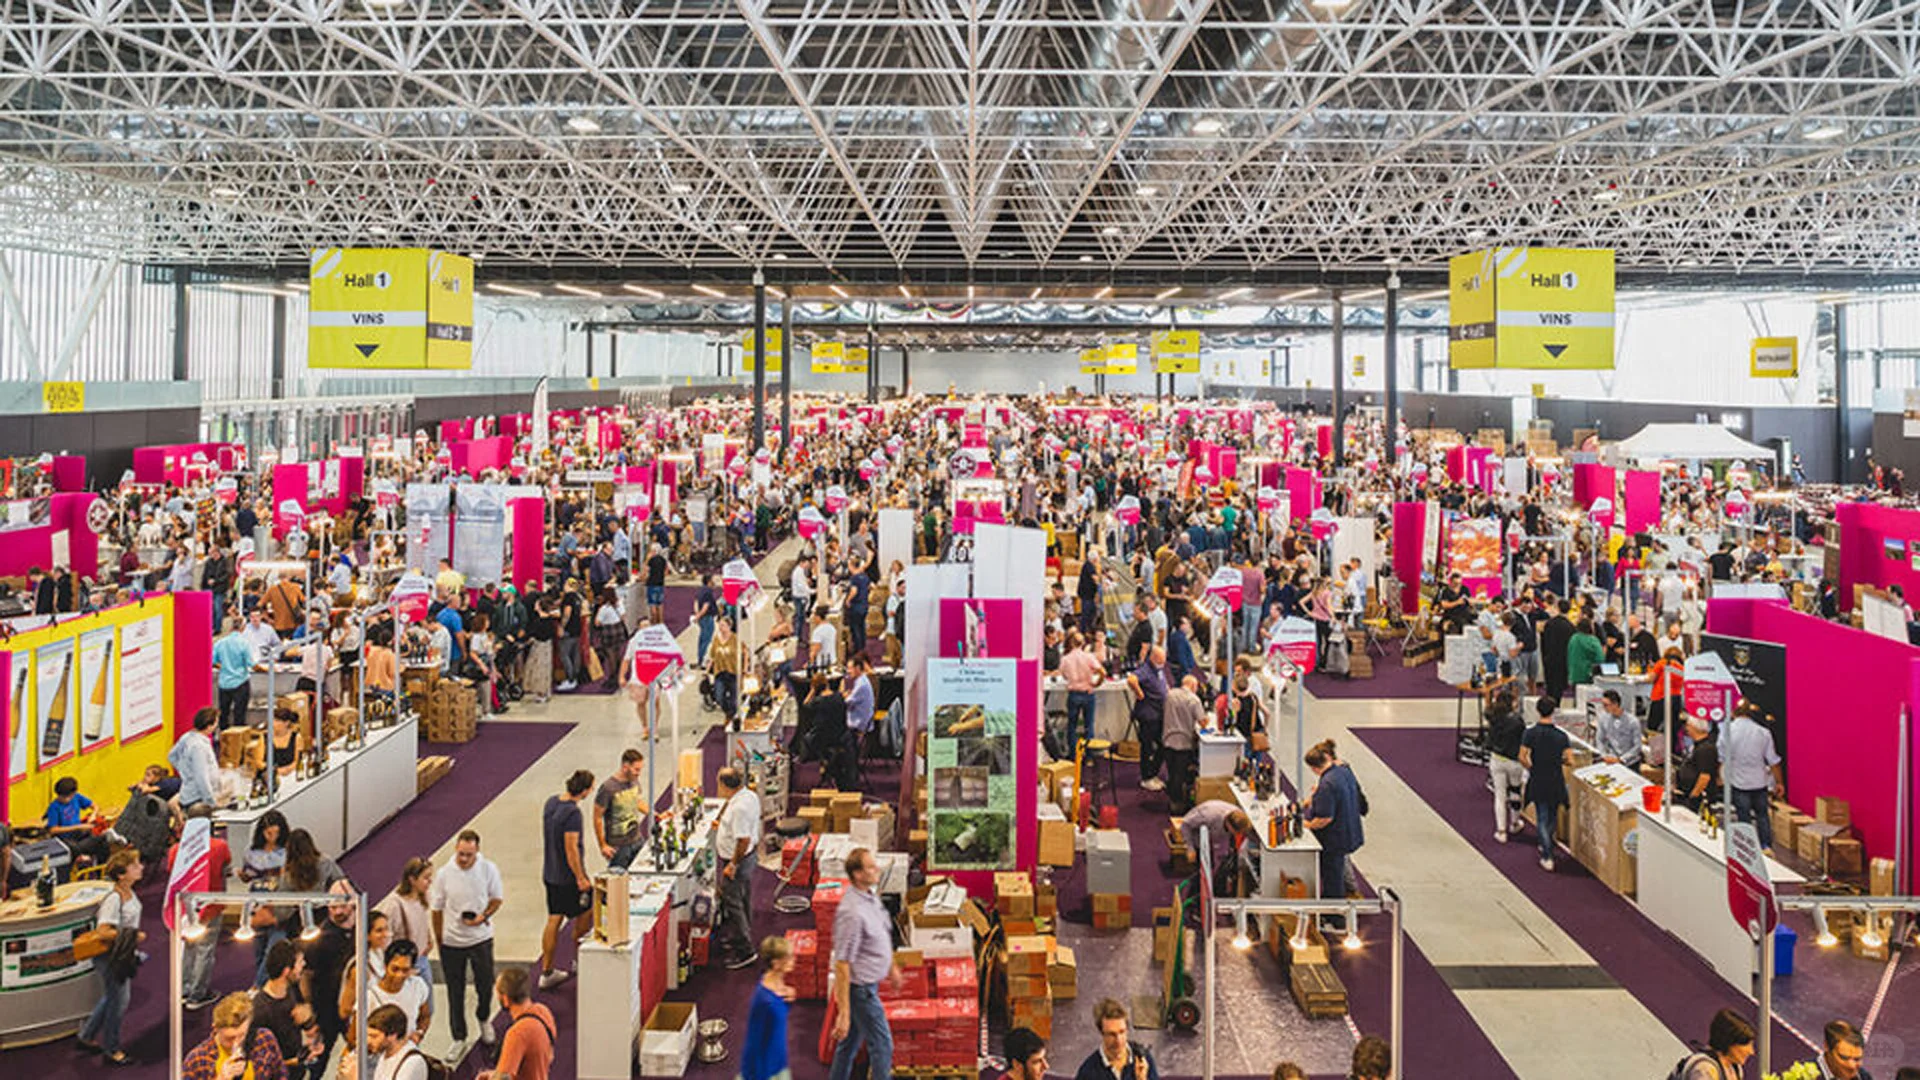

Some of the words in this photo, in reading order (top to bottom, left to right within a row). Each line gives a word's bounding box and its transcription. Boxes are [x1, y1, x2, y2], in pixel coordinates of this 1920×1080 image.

[344, 273, 374, 288] Hall
[377, 272, 387, 288] 1
[1531, 273, 1561, 288] Hall
[1564, 272, 1573, 288] 1
[352, 313, 385, 325] VINS
[1539, 313, 1573, 325] VINS
